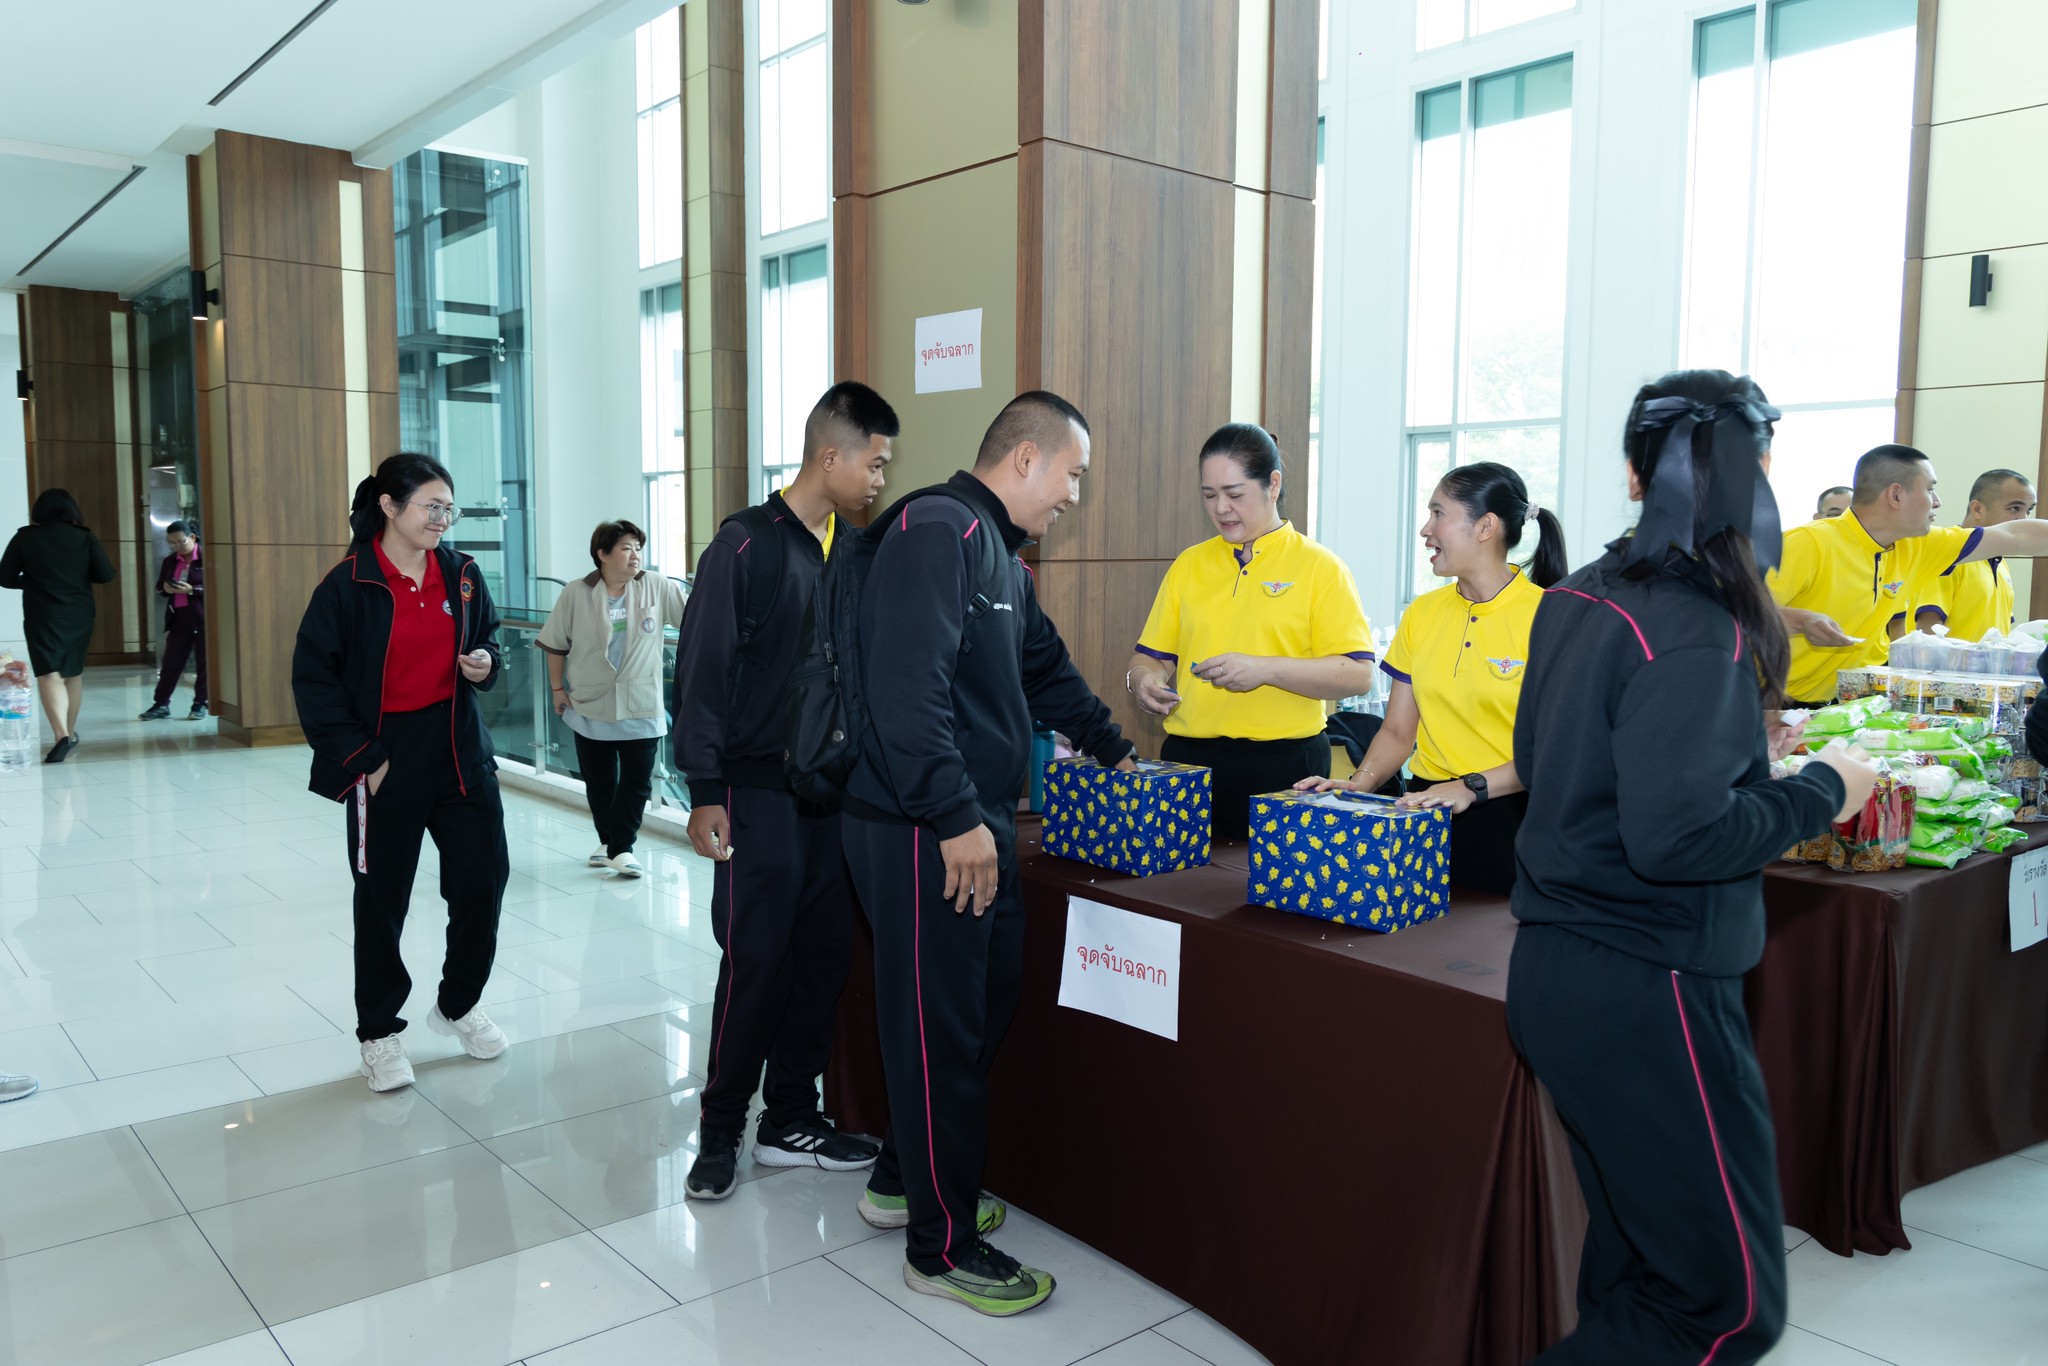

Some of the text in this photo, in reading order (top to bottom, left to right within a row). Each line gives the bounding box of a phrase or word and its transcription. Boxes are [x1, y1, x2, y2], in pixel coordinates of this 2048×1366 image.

[920, 340, 974, 366] จุดจับฉลาก
[2032, 889, 2039, 927] 1
[1077, 944, 1167, 987] จุดจับฉลาก
